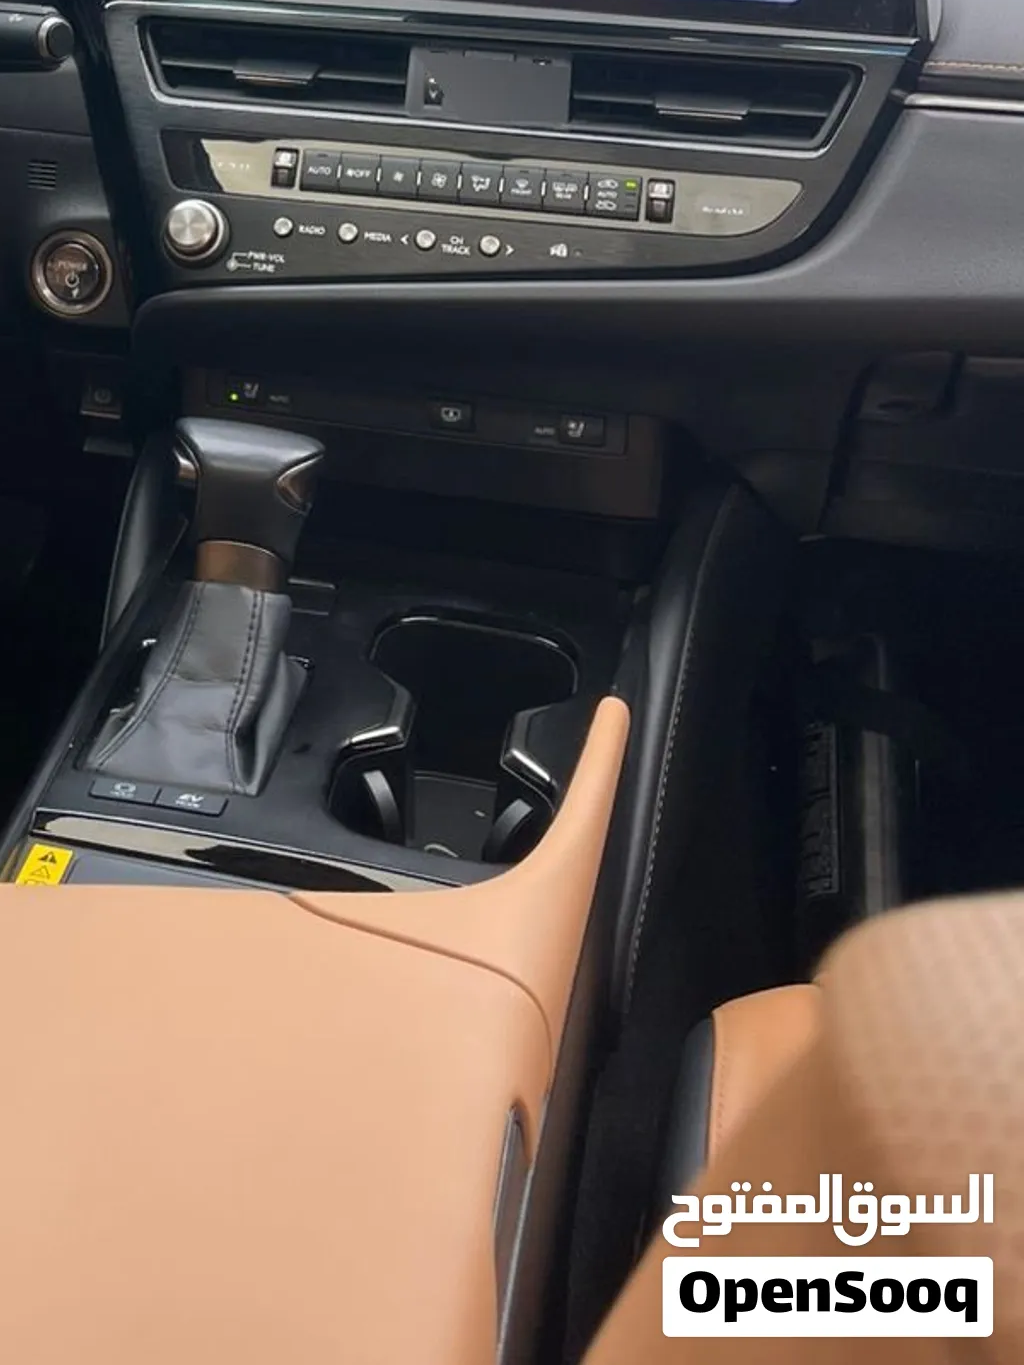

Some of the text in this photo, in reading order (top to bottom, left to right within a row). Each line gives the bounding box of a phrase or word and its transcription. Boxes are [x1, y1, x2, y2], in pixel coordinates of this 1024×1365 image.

[307, 166, 332, 176] AUTO
[298, 224, 327, 235] RADIO
[364, 231, 392, 243] MEDIA
[441, 244, 471, 256] TRACK
